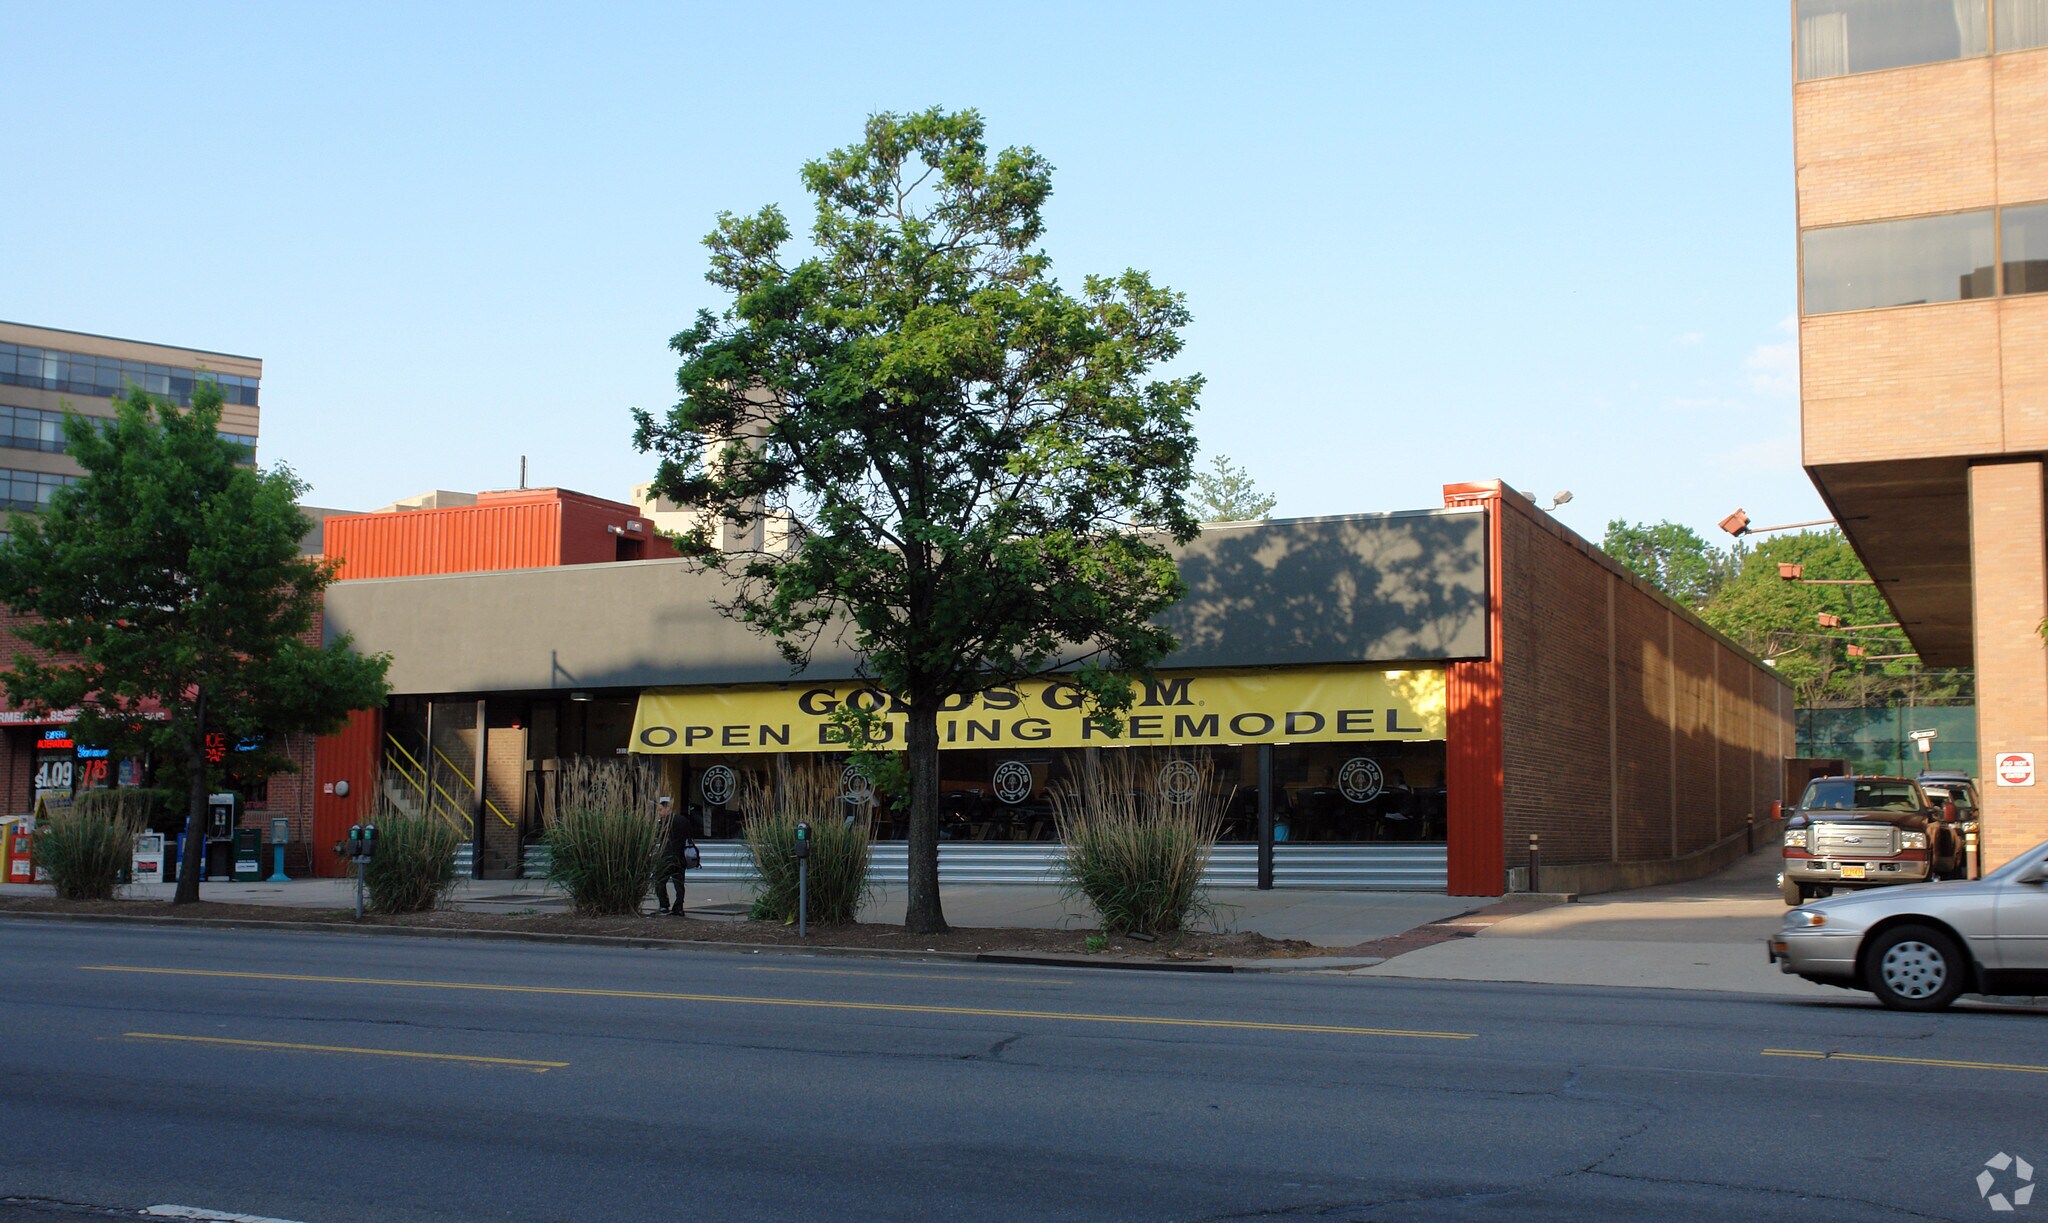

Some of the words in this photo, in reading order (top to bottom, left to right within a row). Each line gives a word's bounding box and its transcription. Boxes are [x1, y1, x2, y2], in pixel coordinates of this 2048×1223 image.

[1041, 678, 1196, 710] GM
[640, 724, 789, 747] OPEN
[819, 717, 1052, 744] DUING
[1082, 709, 1423, 740] REMODEL
[34, 761, 73, 789] $1.09
[999, 787, 1027, 800] GYM
[1345, 785, 1378, 799] GYM
